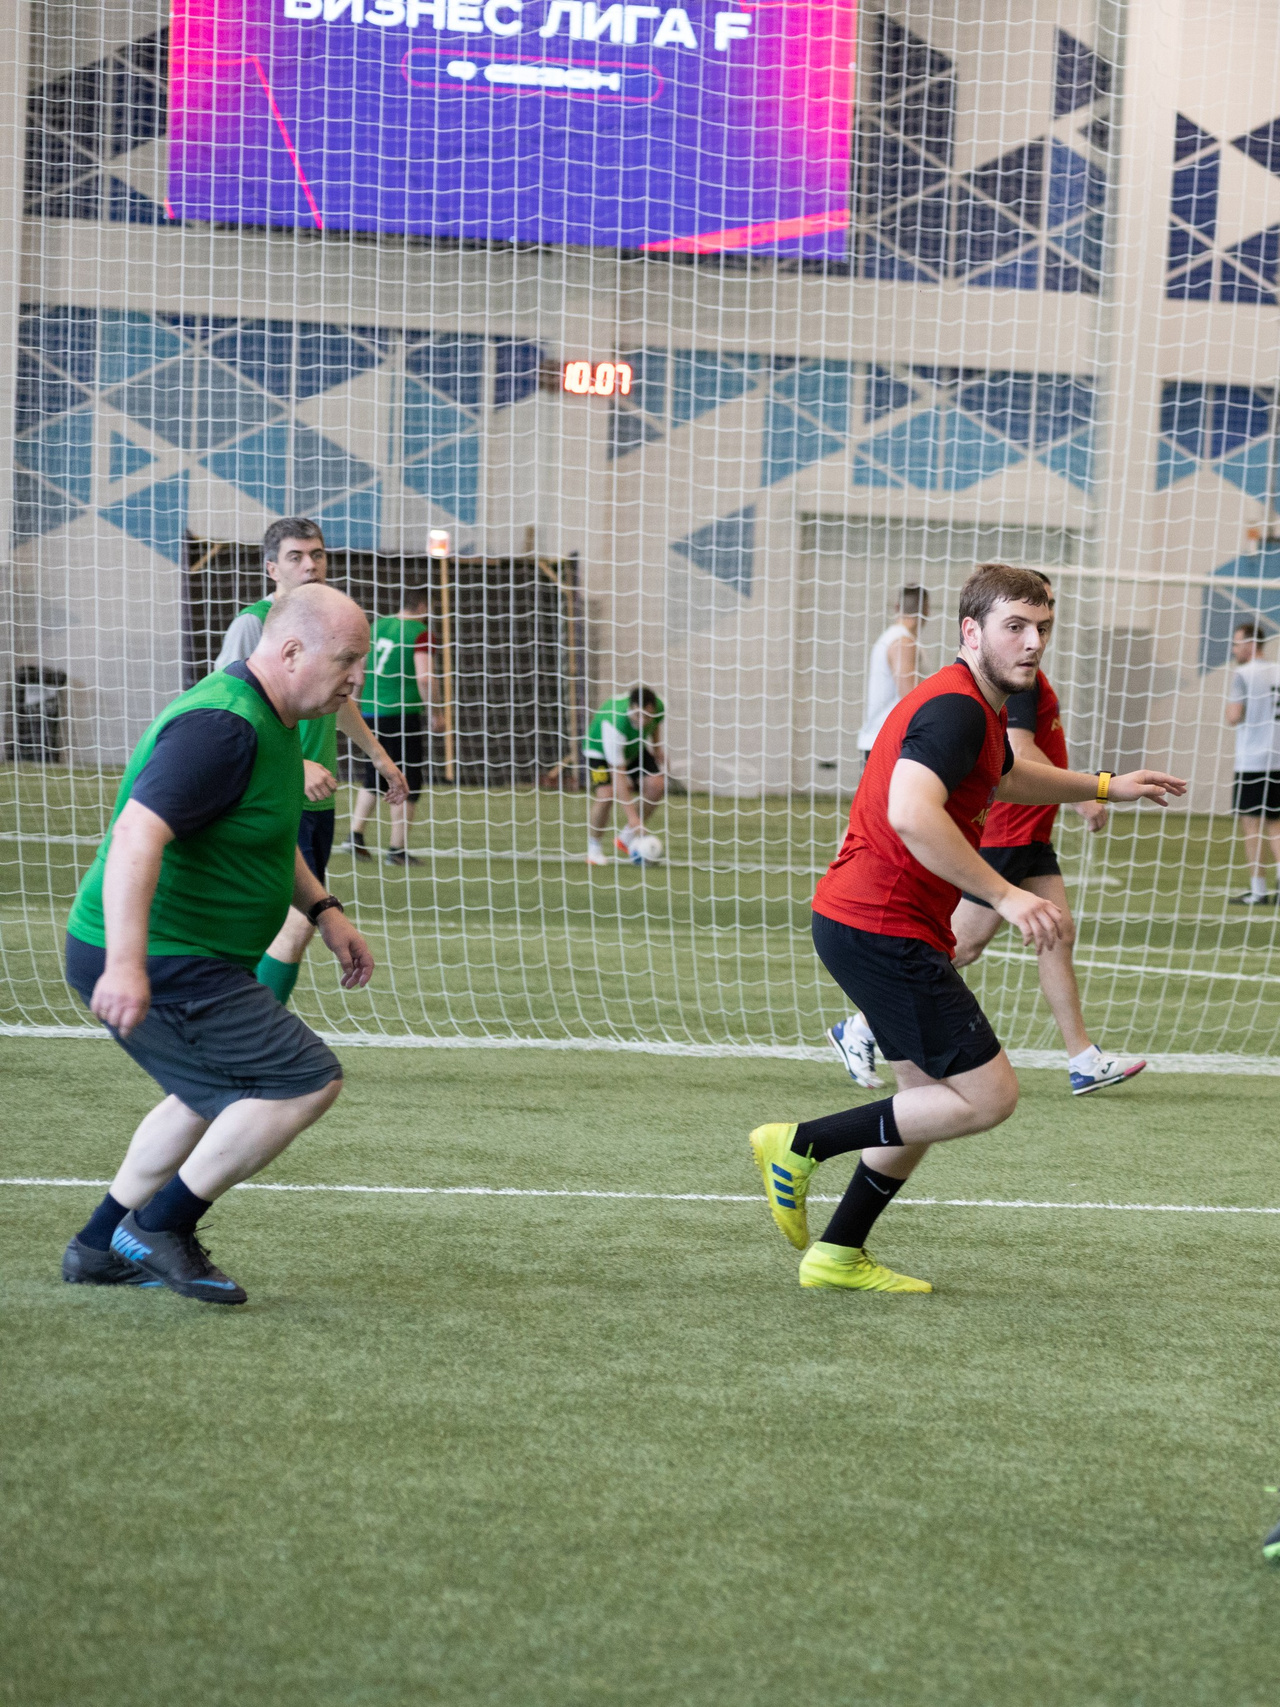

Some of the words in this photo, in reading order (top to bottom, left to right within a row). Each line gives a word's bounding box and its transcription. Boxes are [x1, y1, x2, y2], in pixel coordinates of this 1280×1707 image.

[539, 0, 698, 49] ЛИГА
[714, 11, 752, 51] F
[376, 637, 394, 675] 7
[110, 1226, 154, 1262] NIKE
